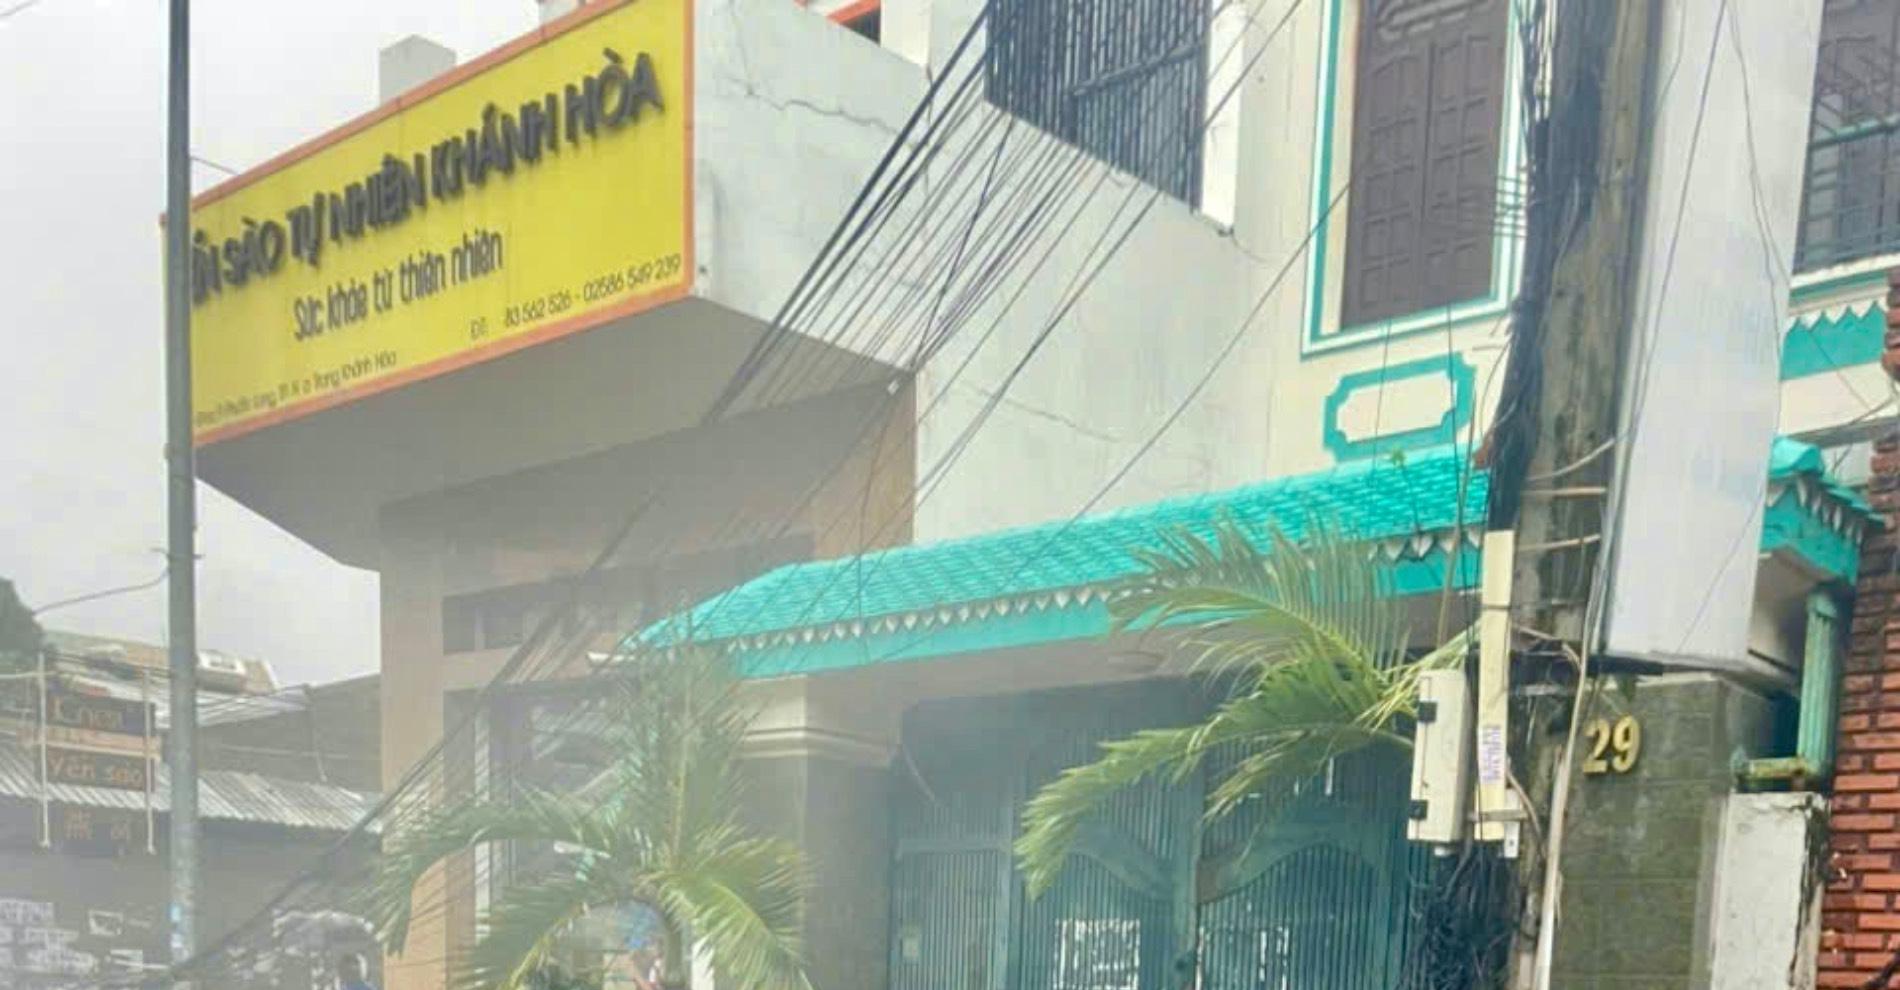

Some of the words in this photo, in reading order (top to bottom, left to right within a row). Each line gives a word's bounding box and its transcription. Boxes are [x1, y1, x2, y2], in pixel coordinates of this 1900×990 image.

[223, 215, 288, 286] SÀO
[286, 190, 325, 268] TỰ
[329, 152, 427, 247] NHIÊN
[431, 92, 559, 203] KHÁNH
[565, 47, 666, 146] HÒA
[400, 249, 447, 305] thiên
[451, 227, 504, 286] nhiên
[1583, 715, 1641, 774] 29
